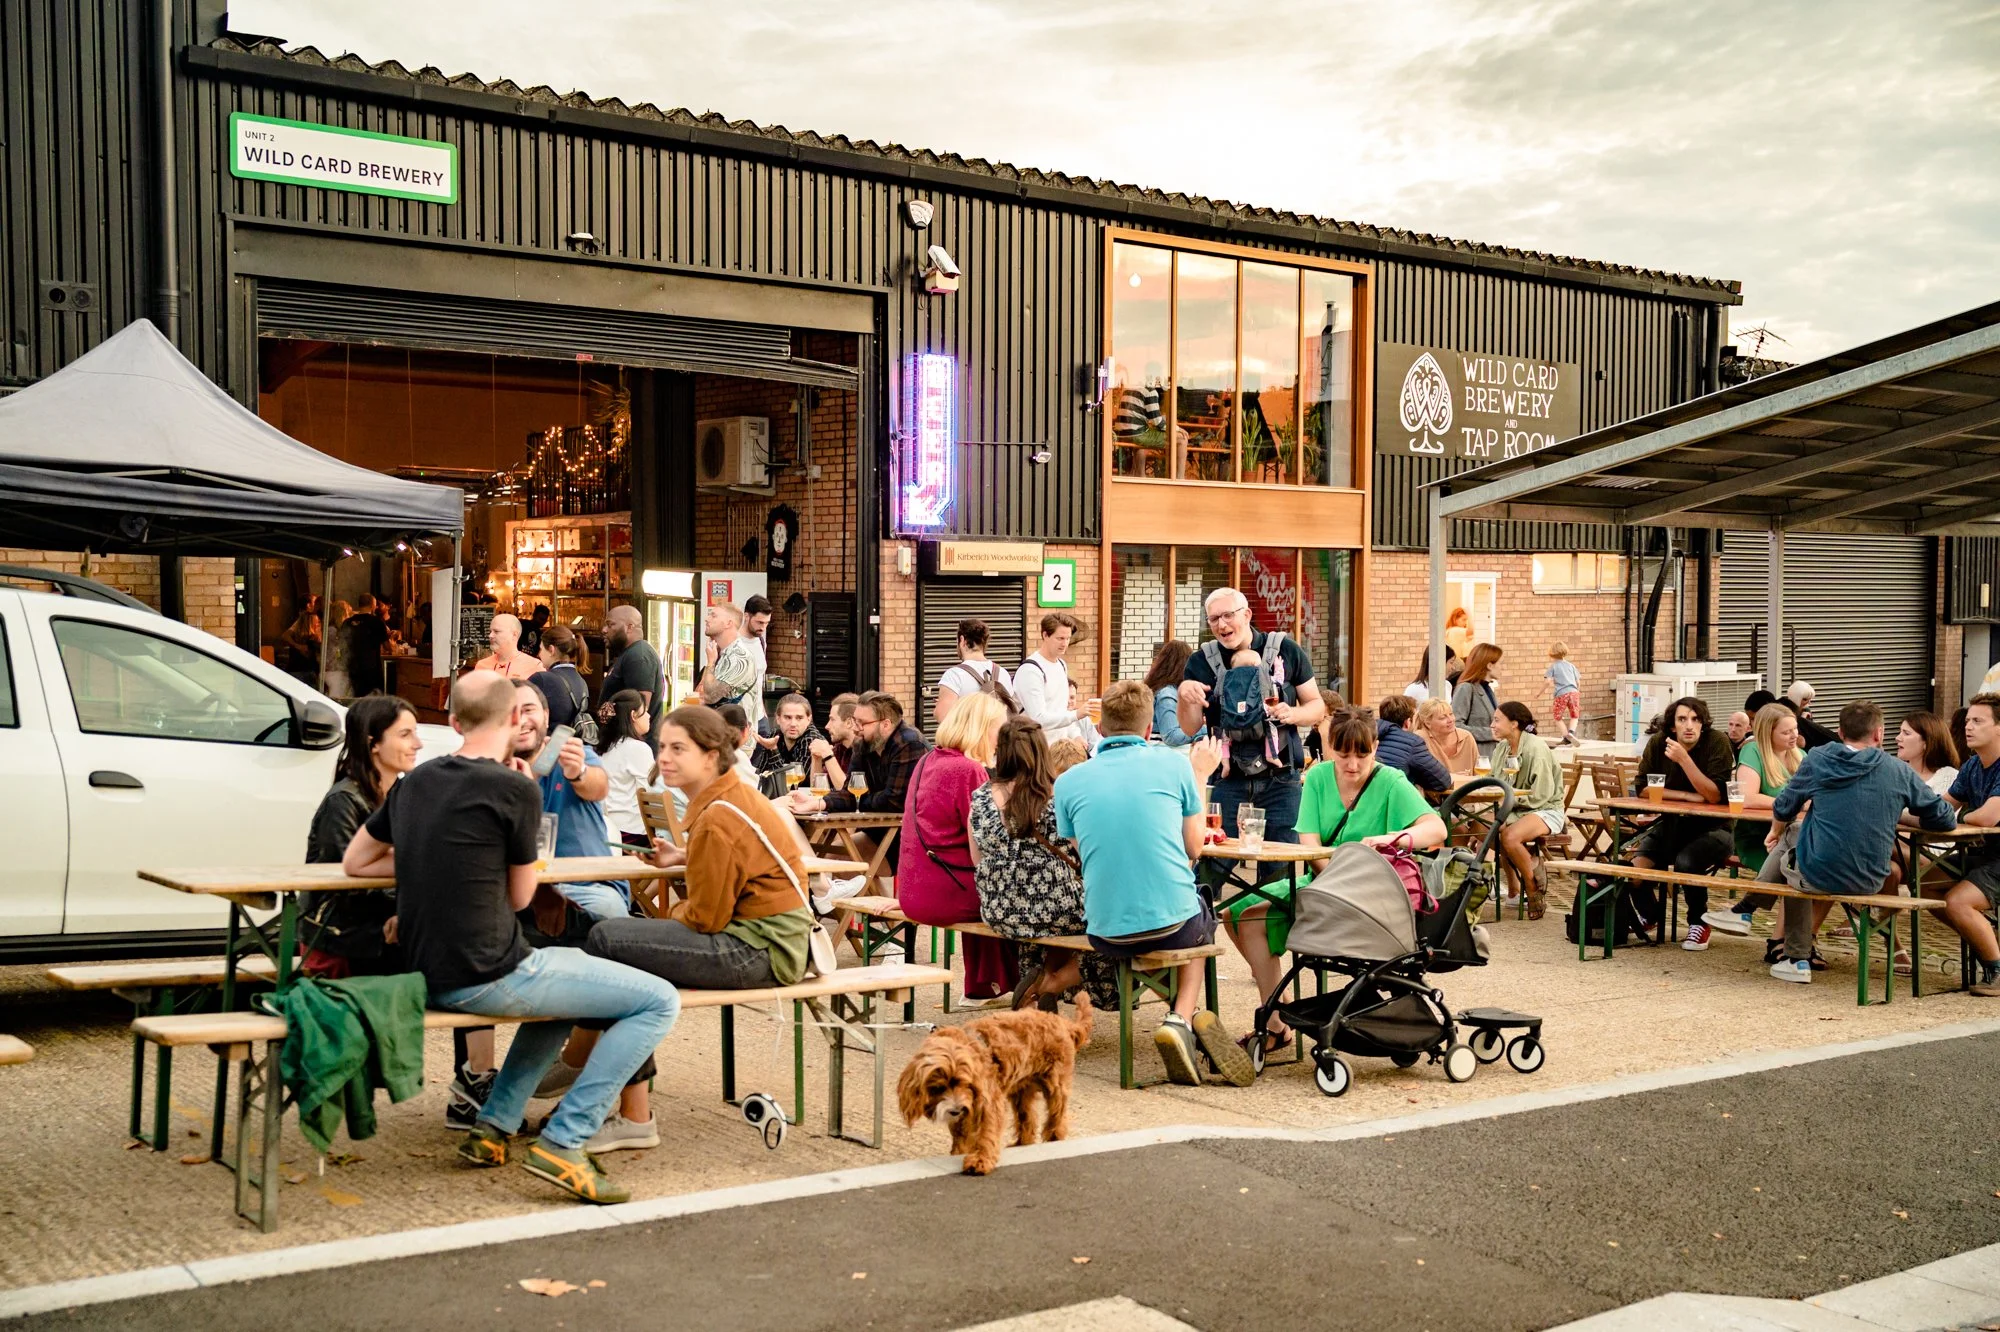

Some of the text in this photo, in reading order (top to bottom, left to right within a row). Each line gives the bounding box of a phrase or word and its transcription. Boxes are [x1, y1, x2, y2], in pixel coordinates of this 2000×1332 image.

[244, 130, 275, 142] UNIT 2
[244, 146, 444, 187] WILD CARD BREWERY
[1462, 356, 1559, 391] WILD CARD
[1464, 386, 1554, 419] BREWERY
[1504, 419, 1518, 429] AND
[1461, 427, 1499, 457] TAP
[957, 553, 1039, 563] Kirberich Woodworking
[1053, 574, 1062, 591] 2
